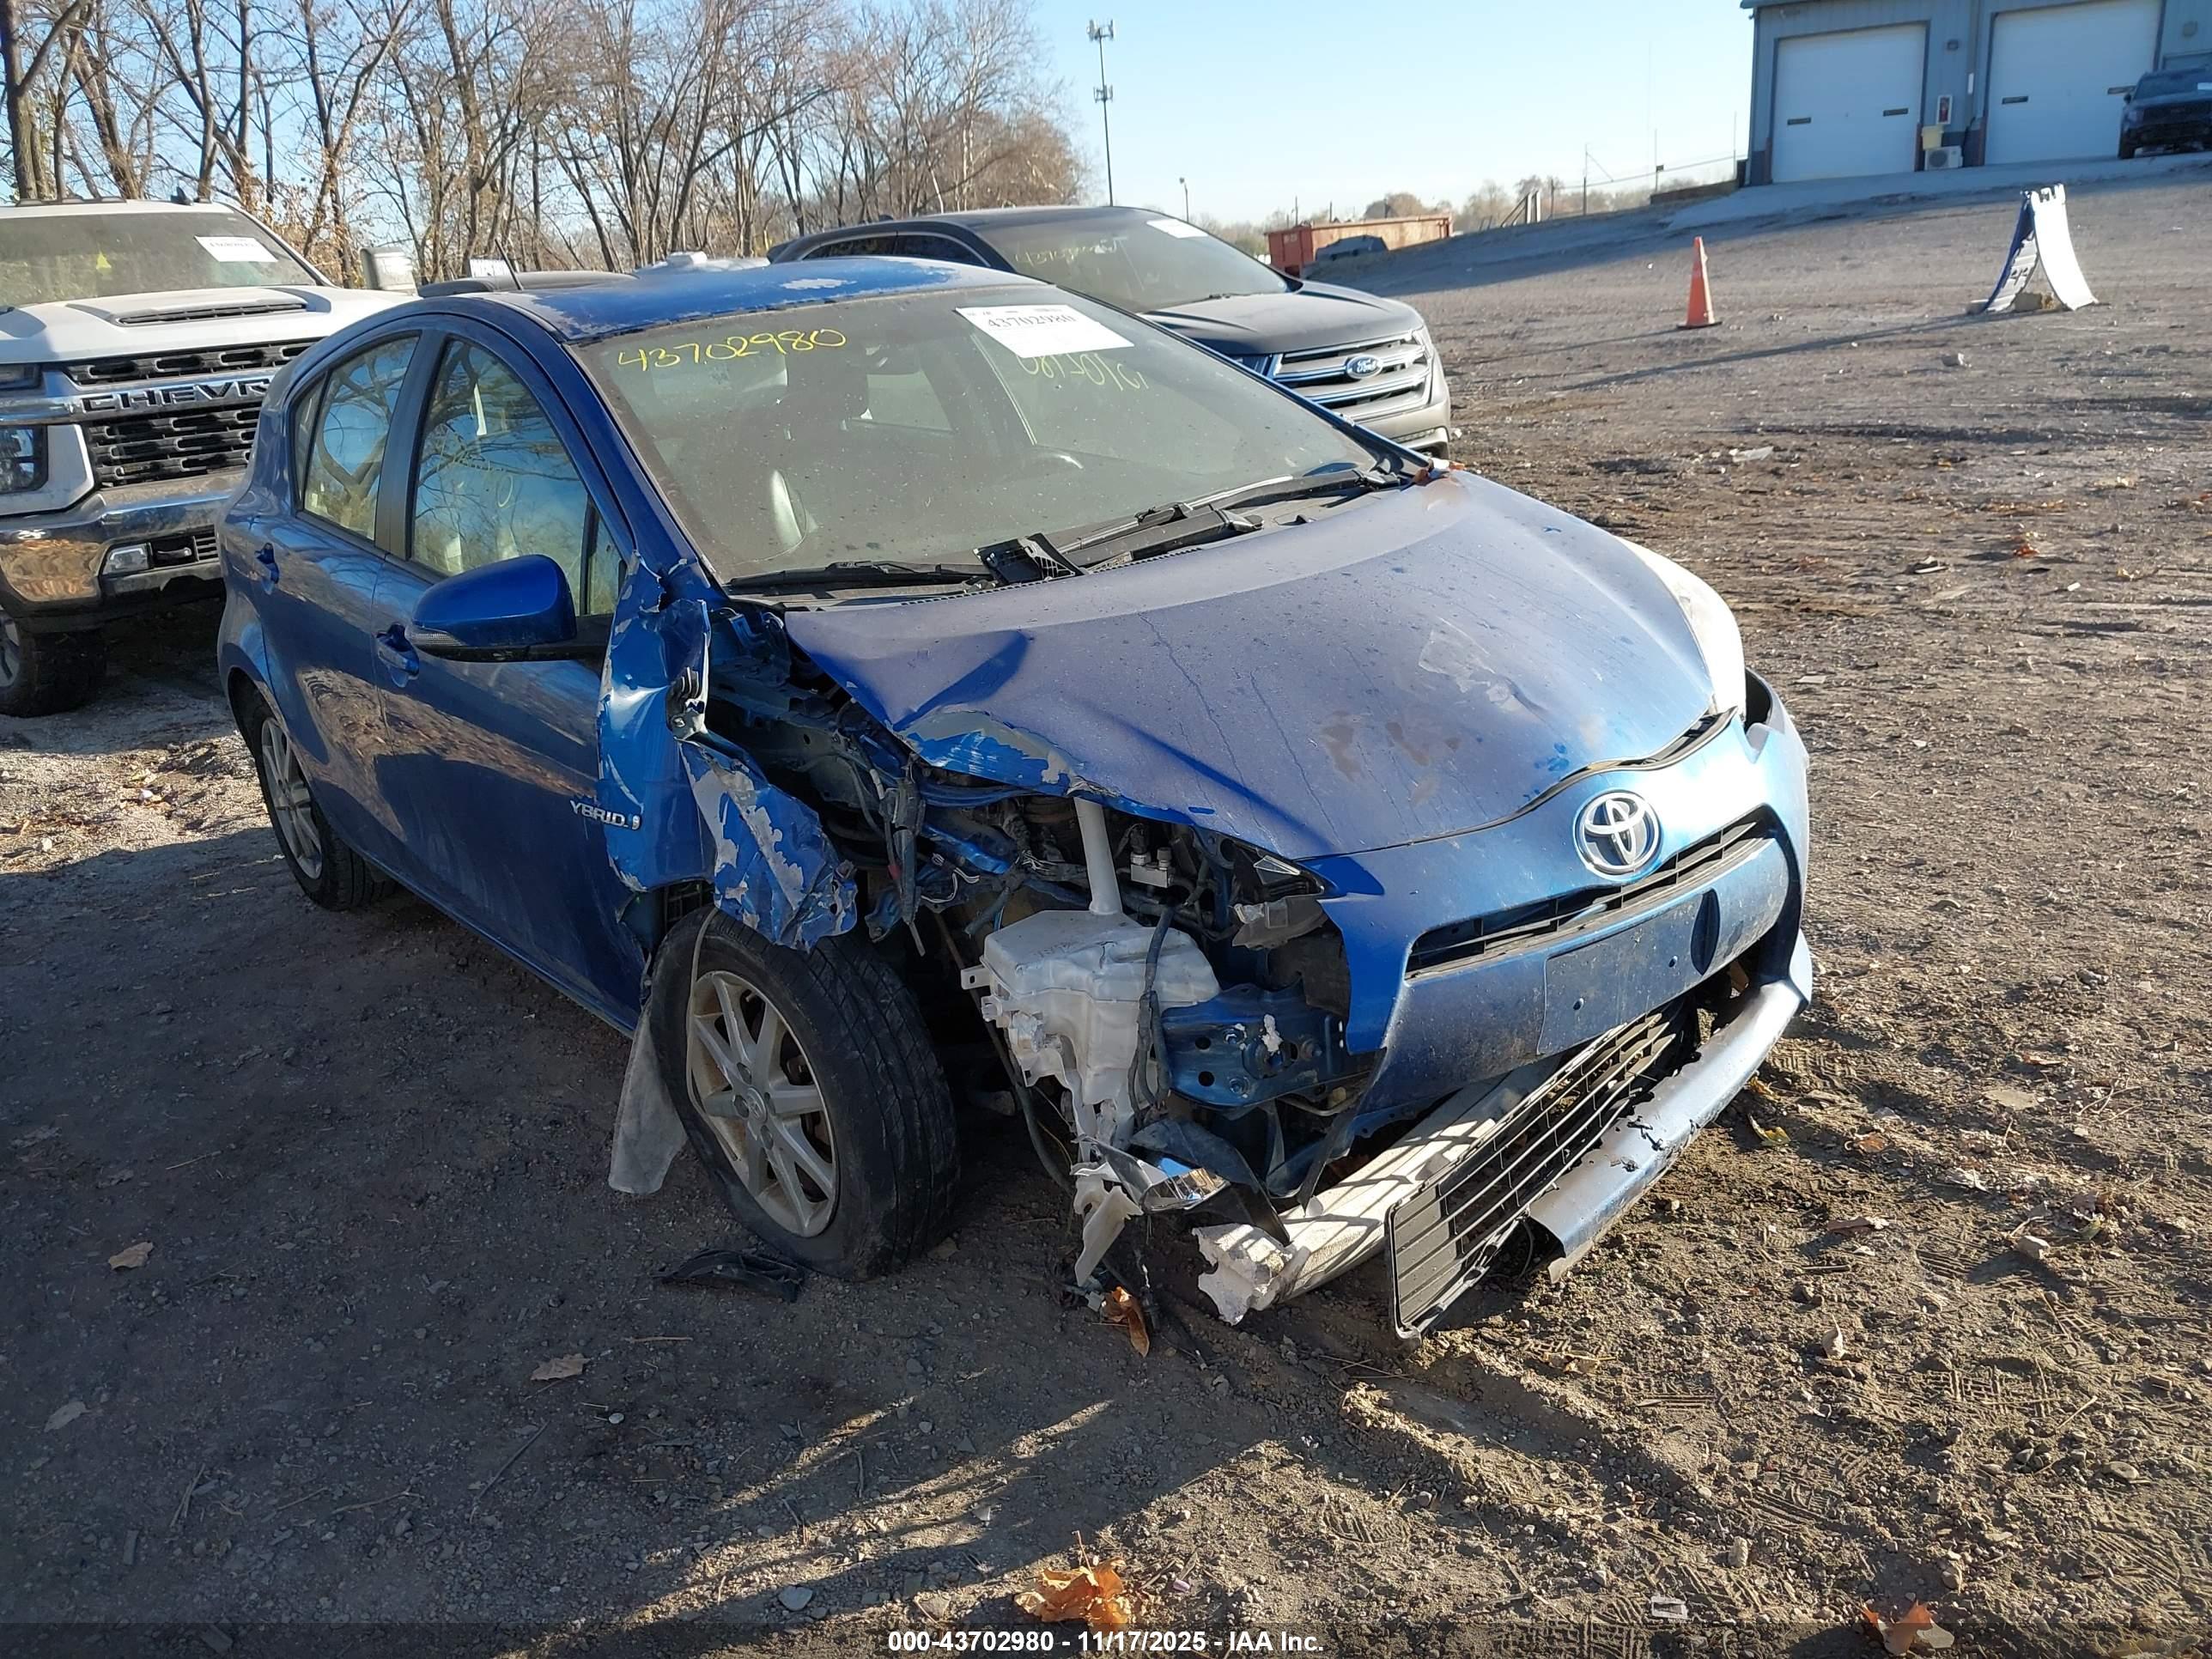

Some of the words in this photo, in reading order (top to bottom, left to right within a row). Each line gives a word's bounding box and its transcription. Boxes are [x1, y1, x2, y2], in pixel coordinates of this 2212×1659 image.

[988, 314, 1076, 328] 43702980
[618, 329, 847, 372] 43702980
[569, 799, 626, 827] YBRID
